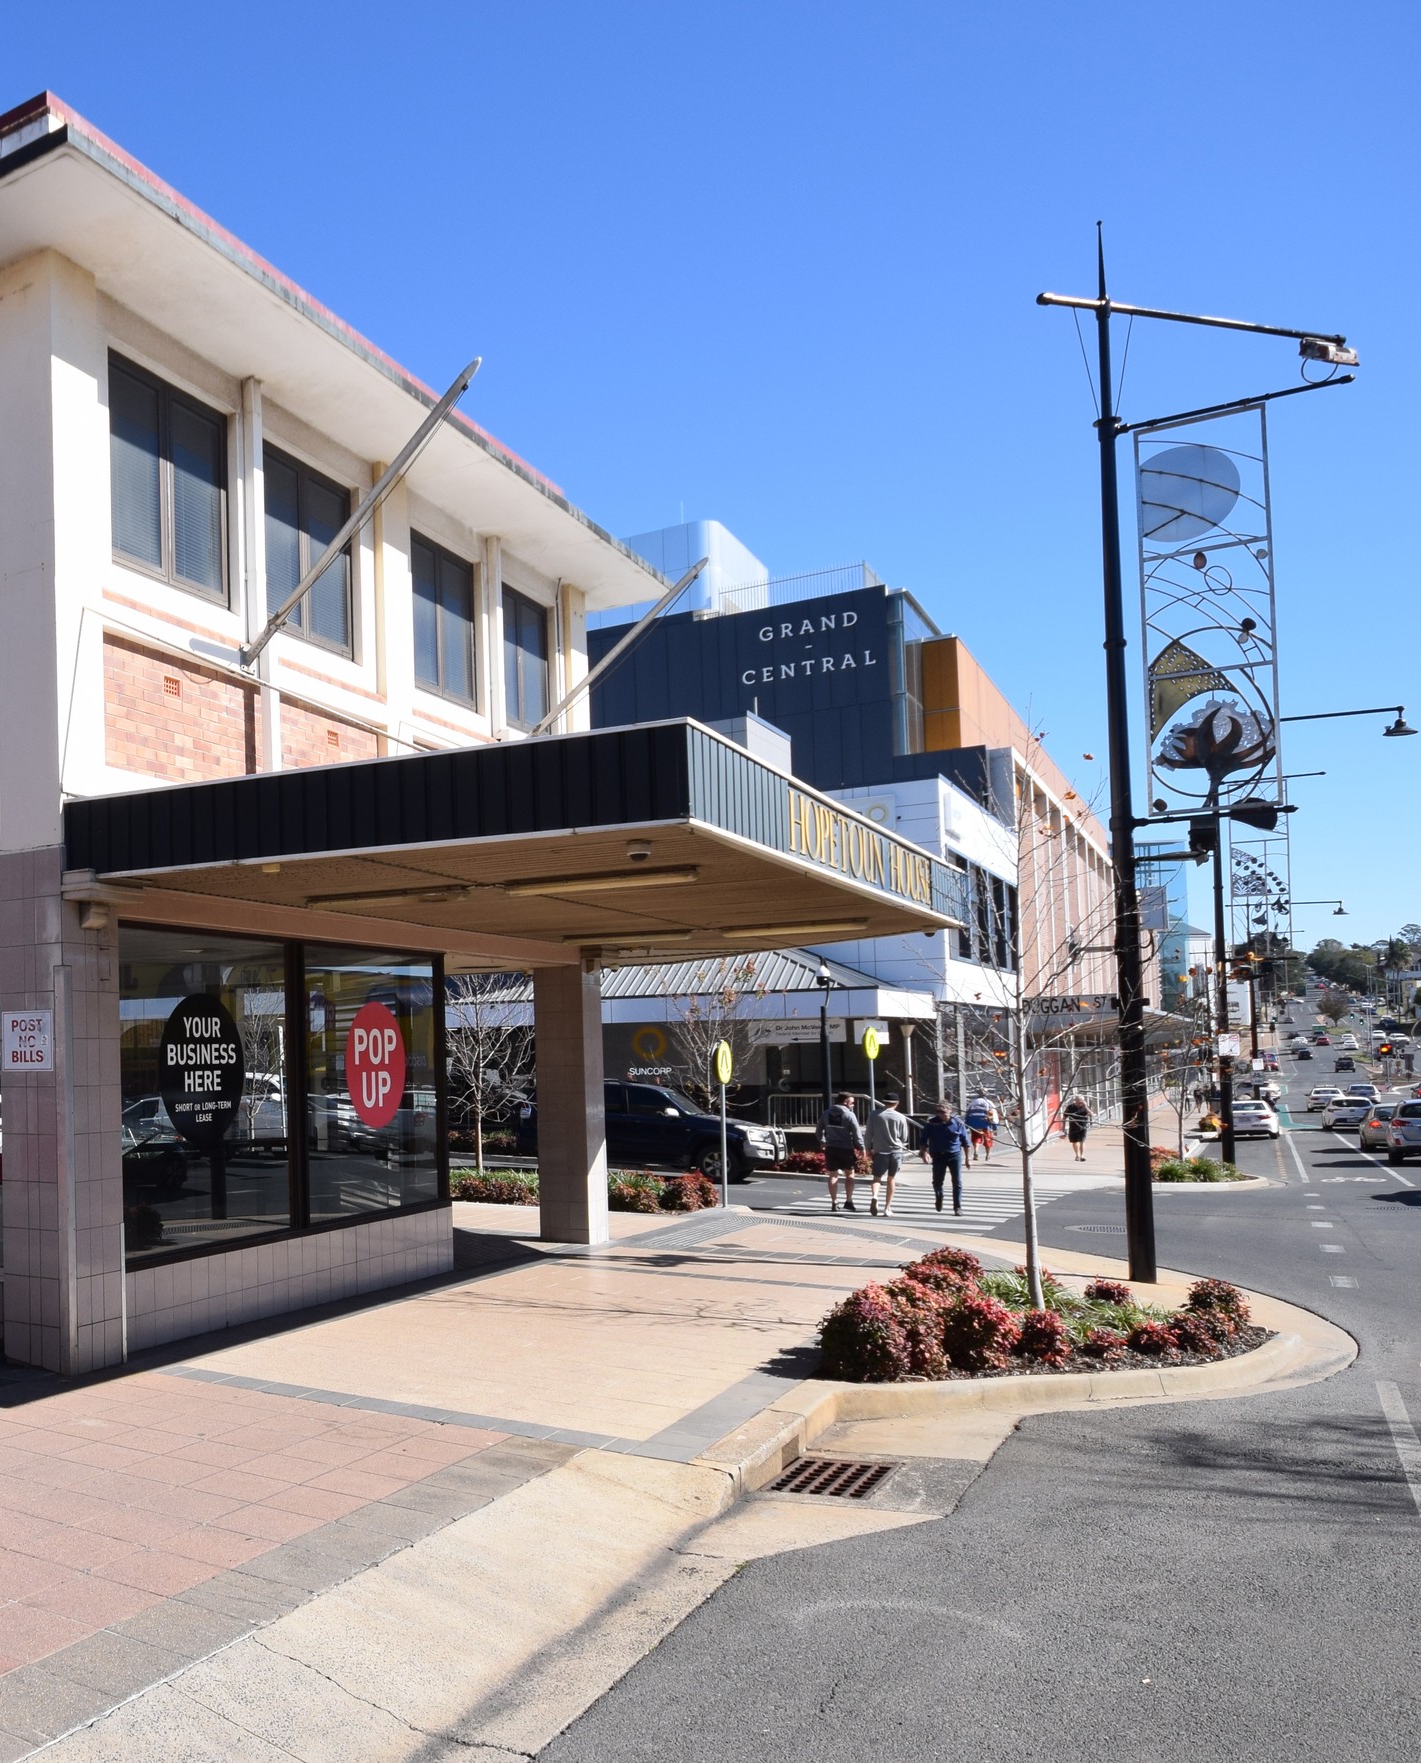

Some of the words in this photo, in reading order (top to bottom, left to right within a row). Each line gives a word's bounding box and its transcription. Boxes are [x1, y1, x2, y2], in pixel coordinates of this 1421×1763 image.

[759, 611, 858, 642] GRAND
[742, 650, 877, 685] CENTRAL
[788, 789, 885, 890] HOPETOUN
[888, 842, 931, 905] HOUSE
[1094, 997, 1107, 1008] ST
[11, 1019, 43, 1032] POST
[183, 1016, 221, 1038] YOUR
[12, 1050, 44, 1062] BILLS
[167, 1043, 236, 1066] BUSINESS
[354, 1028, 397, 1065] POP
[184, 1070, 222, 1092] HERE
[629, 1067, 672, 1076] SUNCORP
[361, 1071, 391, 1109] UP
[175, 1103, 193, 1112] SHORT
[202, 1101, 232, 1111] LONG-TERM
[195, 1113, 212, 1122] LEASE
